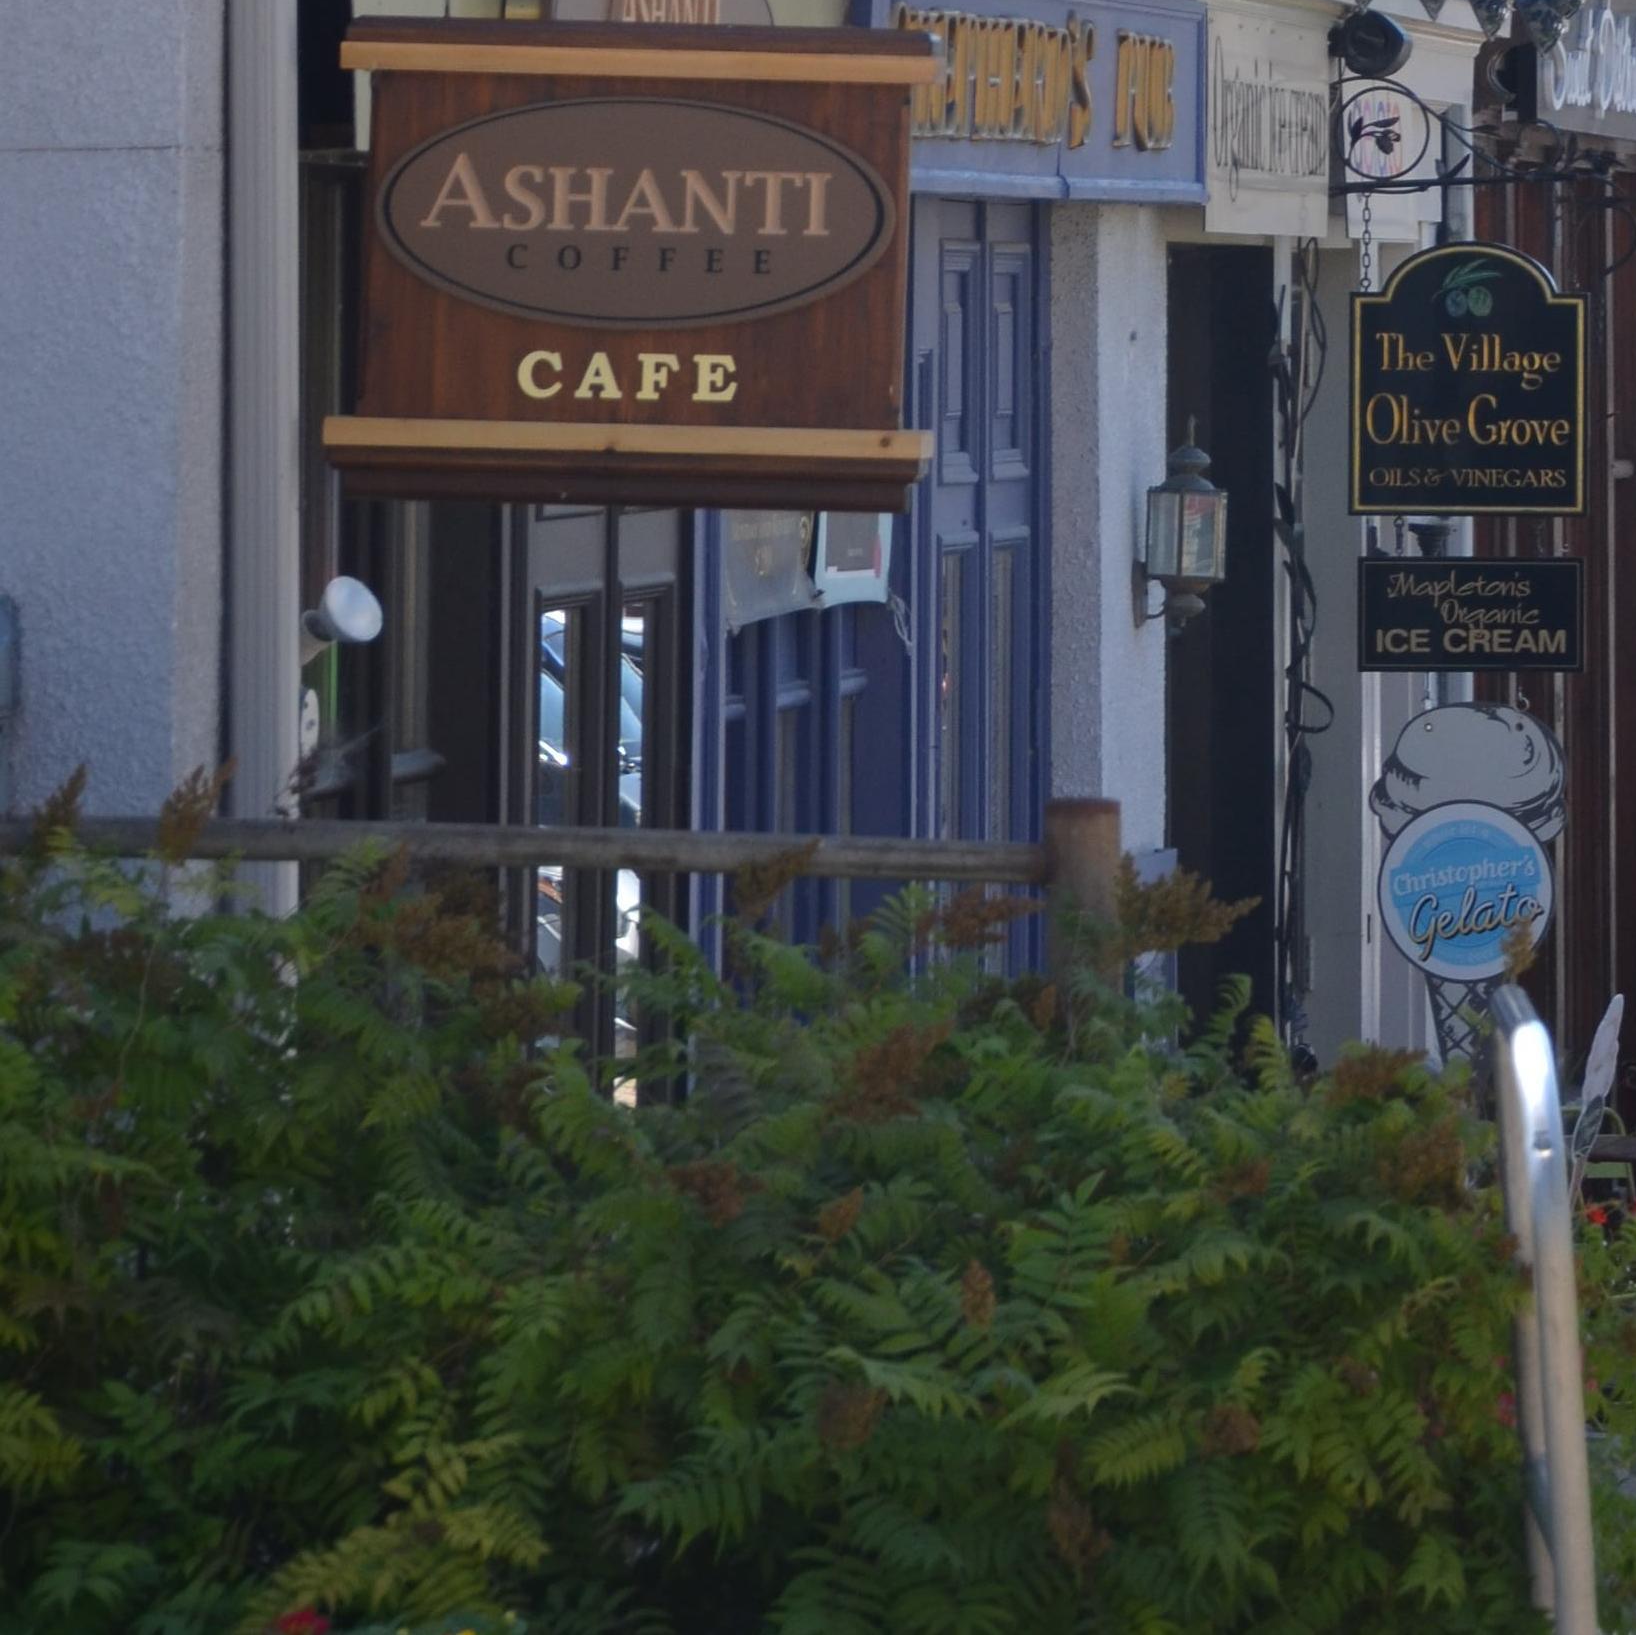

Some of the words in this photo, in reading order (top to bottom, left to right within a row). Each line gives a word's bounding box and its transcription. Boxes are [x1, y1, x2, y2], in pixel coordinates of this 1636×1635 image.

[420, 152, 832, 237] ASHANTI
[506, 242, 772, 274] COFFEE
[517, 350, 739, 402] CAFE
[1375, 332, 1434, 372] The
[1441, 332, 1562, 390] Village
[1366, 392, 1460, 445] Olive
[1467, 393, 1570, 446] Grove
[1369, 467, 1421, 486] OILS
[1451, 468, 1567, 488] VINEGARS
[1386, 570, 1531, 608] Mapleton's
[1440, 599, 1541, 632] Organic
[1376, 628, 1431, 654] ICE
[1443, 628, 1567, 654] CREAM
[1393, 855, 1536, 896] Christopher's
[1409, 883, 1545, 961] Gelato
